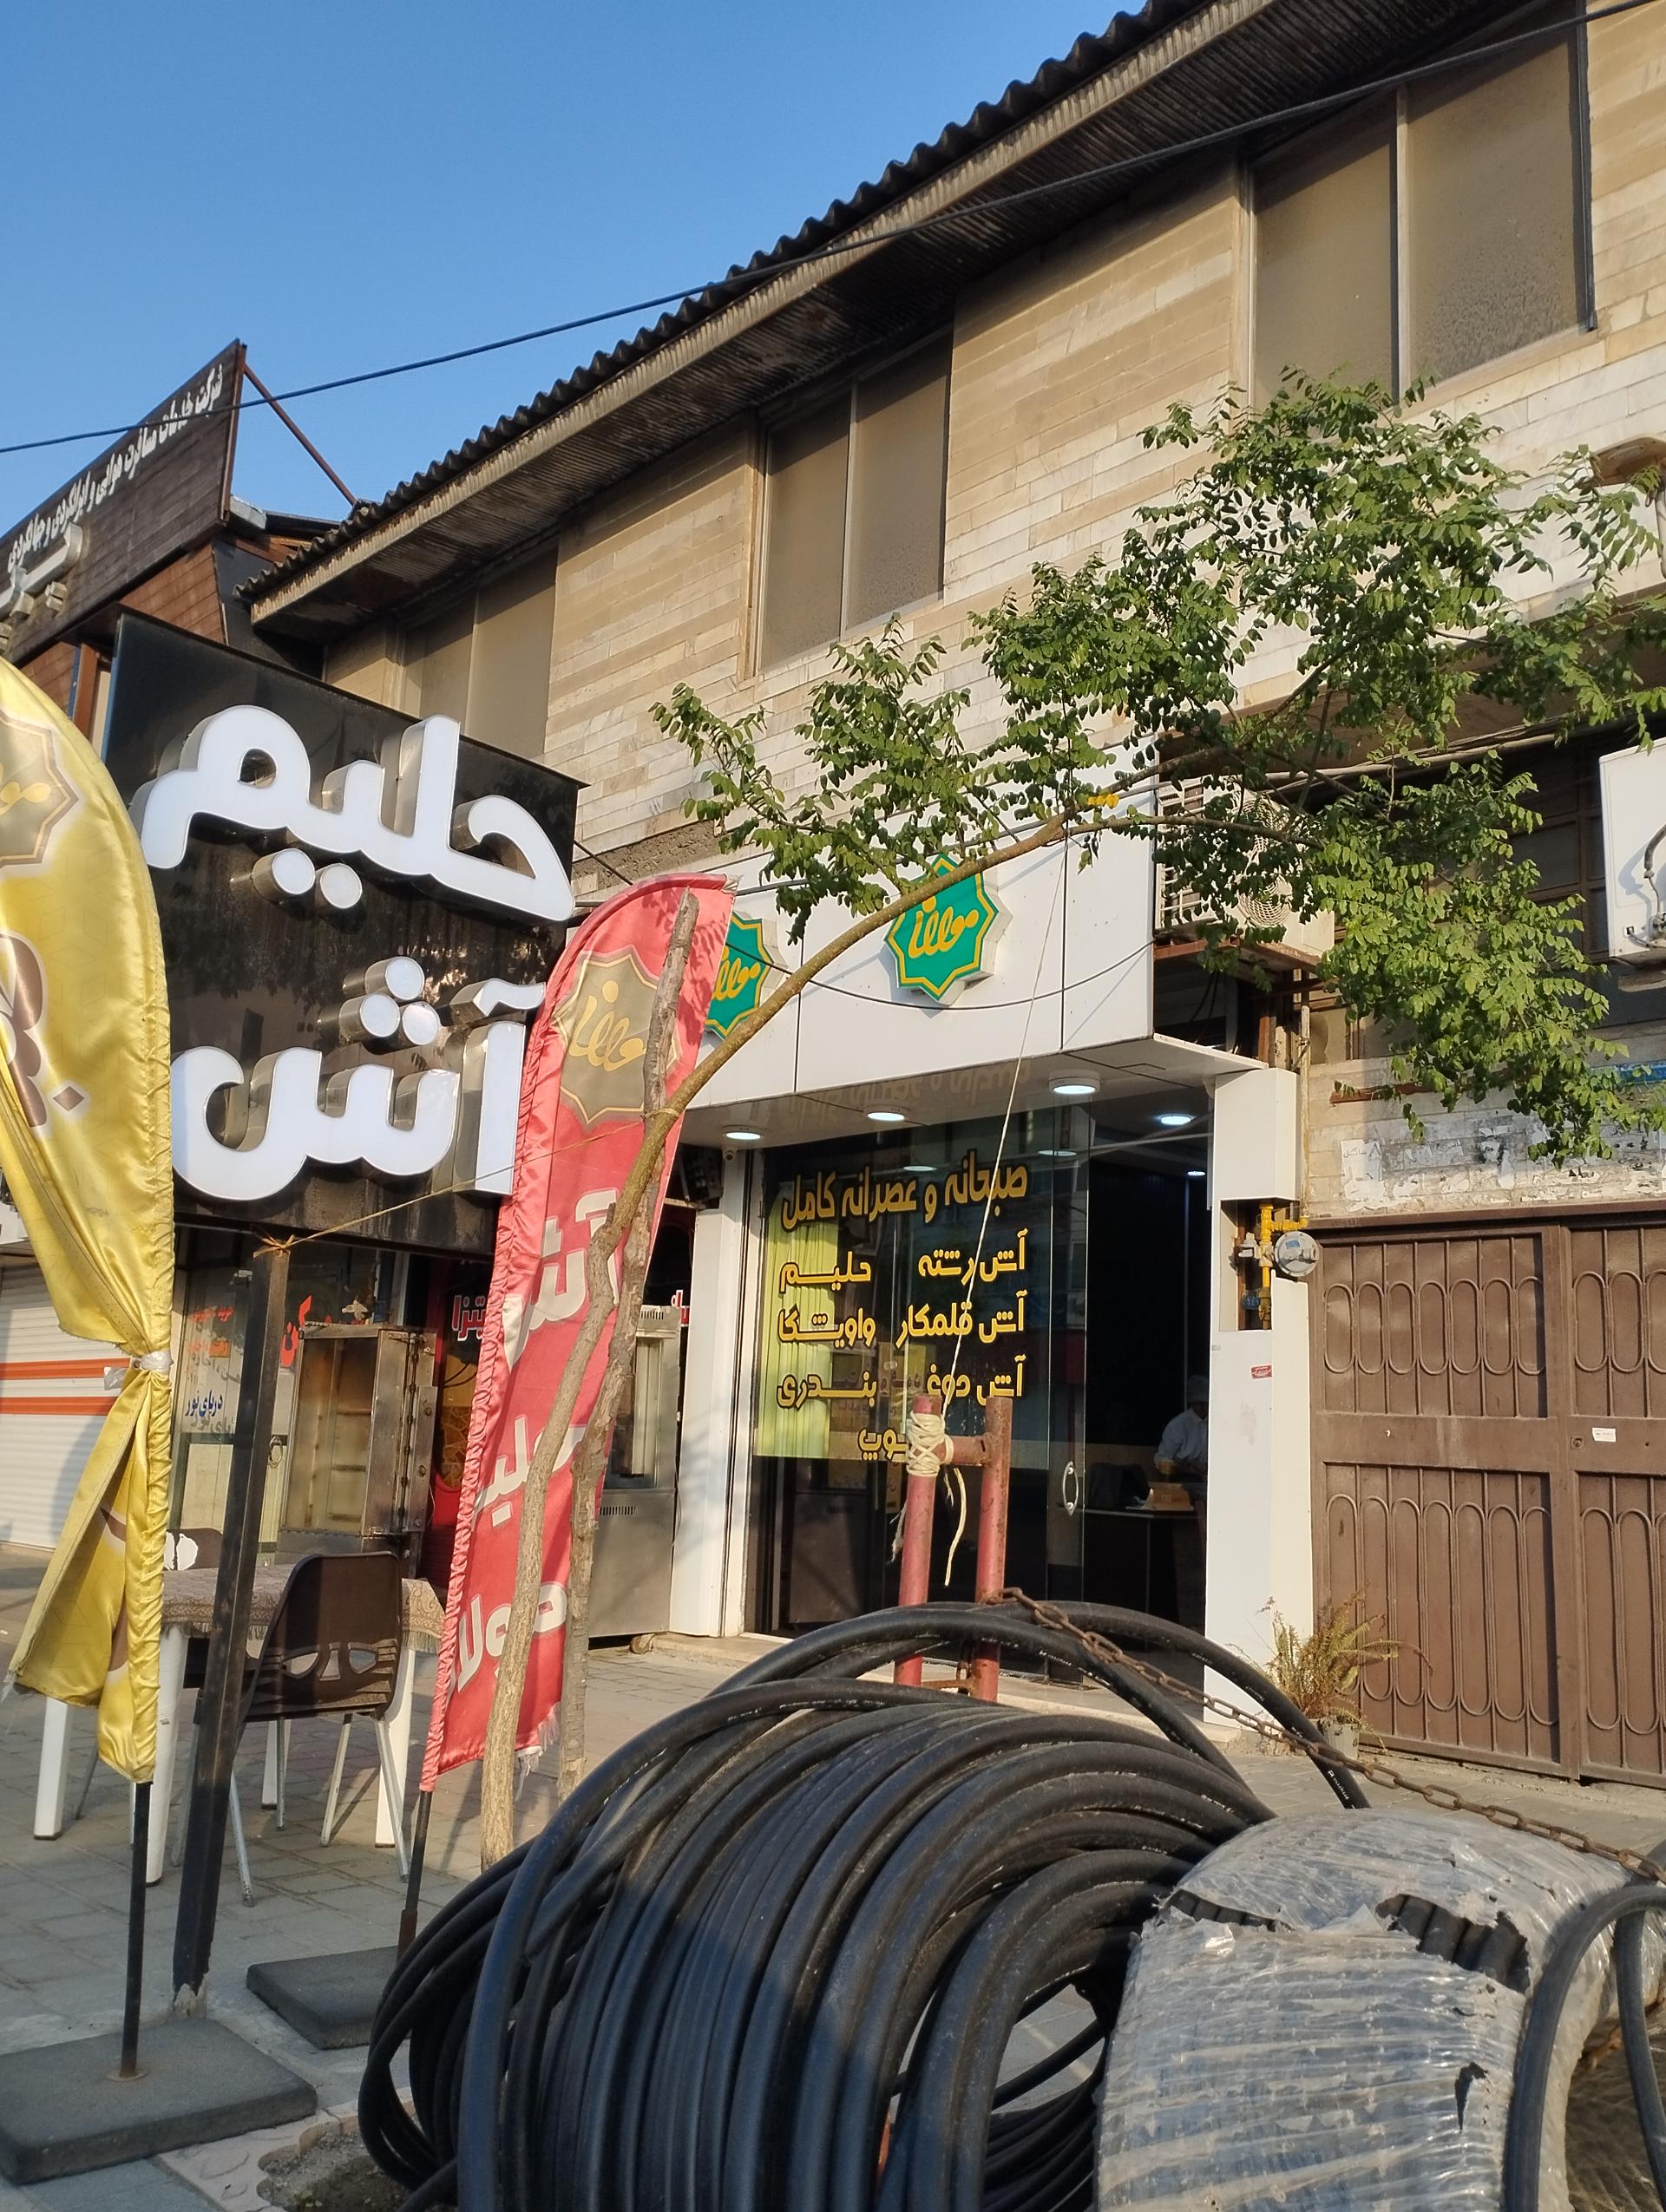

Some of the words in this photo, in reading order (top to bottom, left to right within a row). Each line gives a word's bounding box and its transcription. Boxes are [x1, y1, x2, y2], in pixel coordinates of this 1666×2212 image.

[139, 704, 576, 921] حلیم
[171, 956, 547, 1201] آش
[782, 1171, 836, 1230] کامل
[842, 1165, 917, 1222] عصرانه
[924, 1183, 938, 1224] و
[944, 1151, 1028, 1216] صبحانه
[780, 1251, 871, 1293] حلیم
[918, 1249, 975, 1286] رشته
[980, 1227, 1028, 1282] آش
[895, 1301, 973, 1349] قلمکار
[978, 1289, 1028, 1344] آش
[777, 1371, 877, 1408] بندری
[927, 1363, 970, 1404] دوغ
[858, 1430, 909, 1461] وپ
